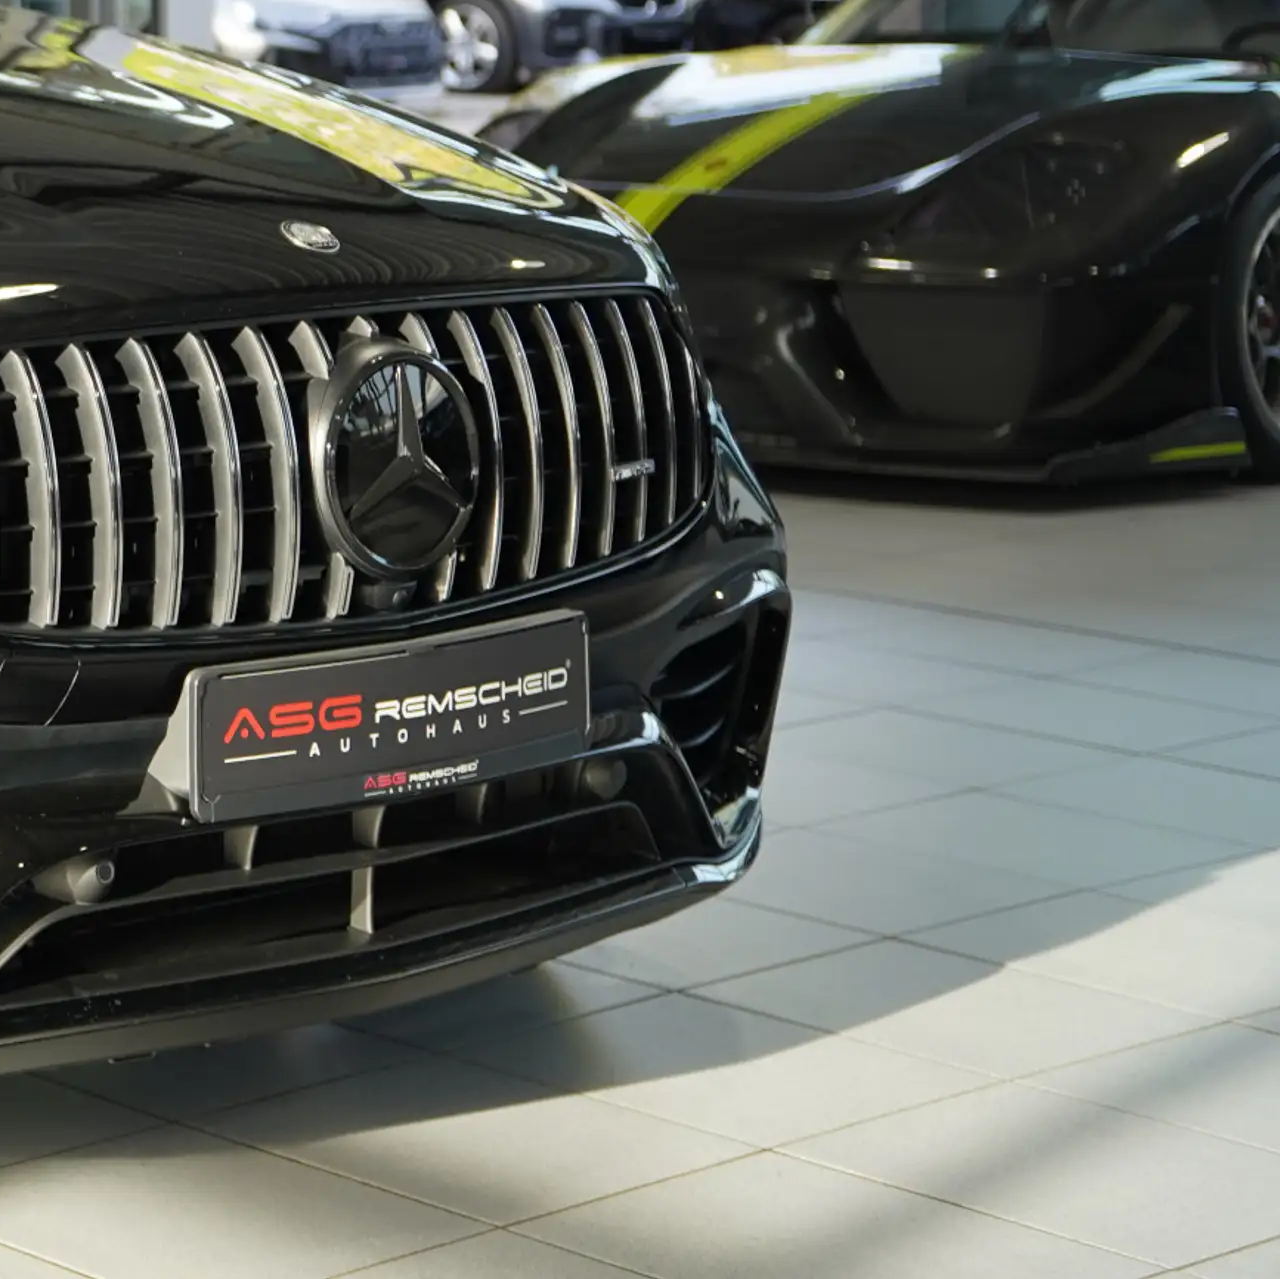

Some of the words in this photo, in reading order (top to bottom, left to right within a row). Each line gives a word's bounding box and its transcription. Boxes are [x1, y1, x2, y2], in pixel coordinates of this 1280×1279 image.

[224, 694, 363, 744] ASG
[375, 666, 569, 724] REMSCHEID
[309, 709, 511, 758] AUTOHAUS
[364, 771, 407, 790] ASG
